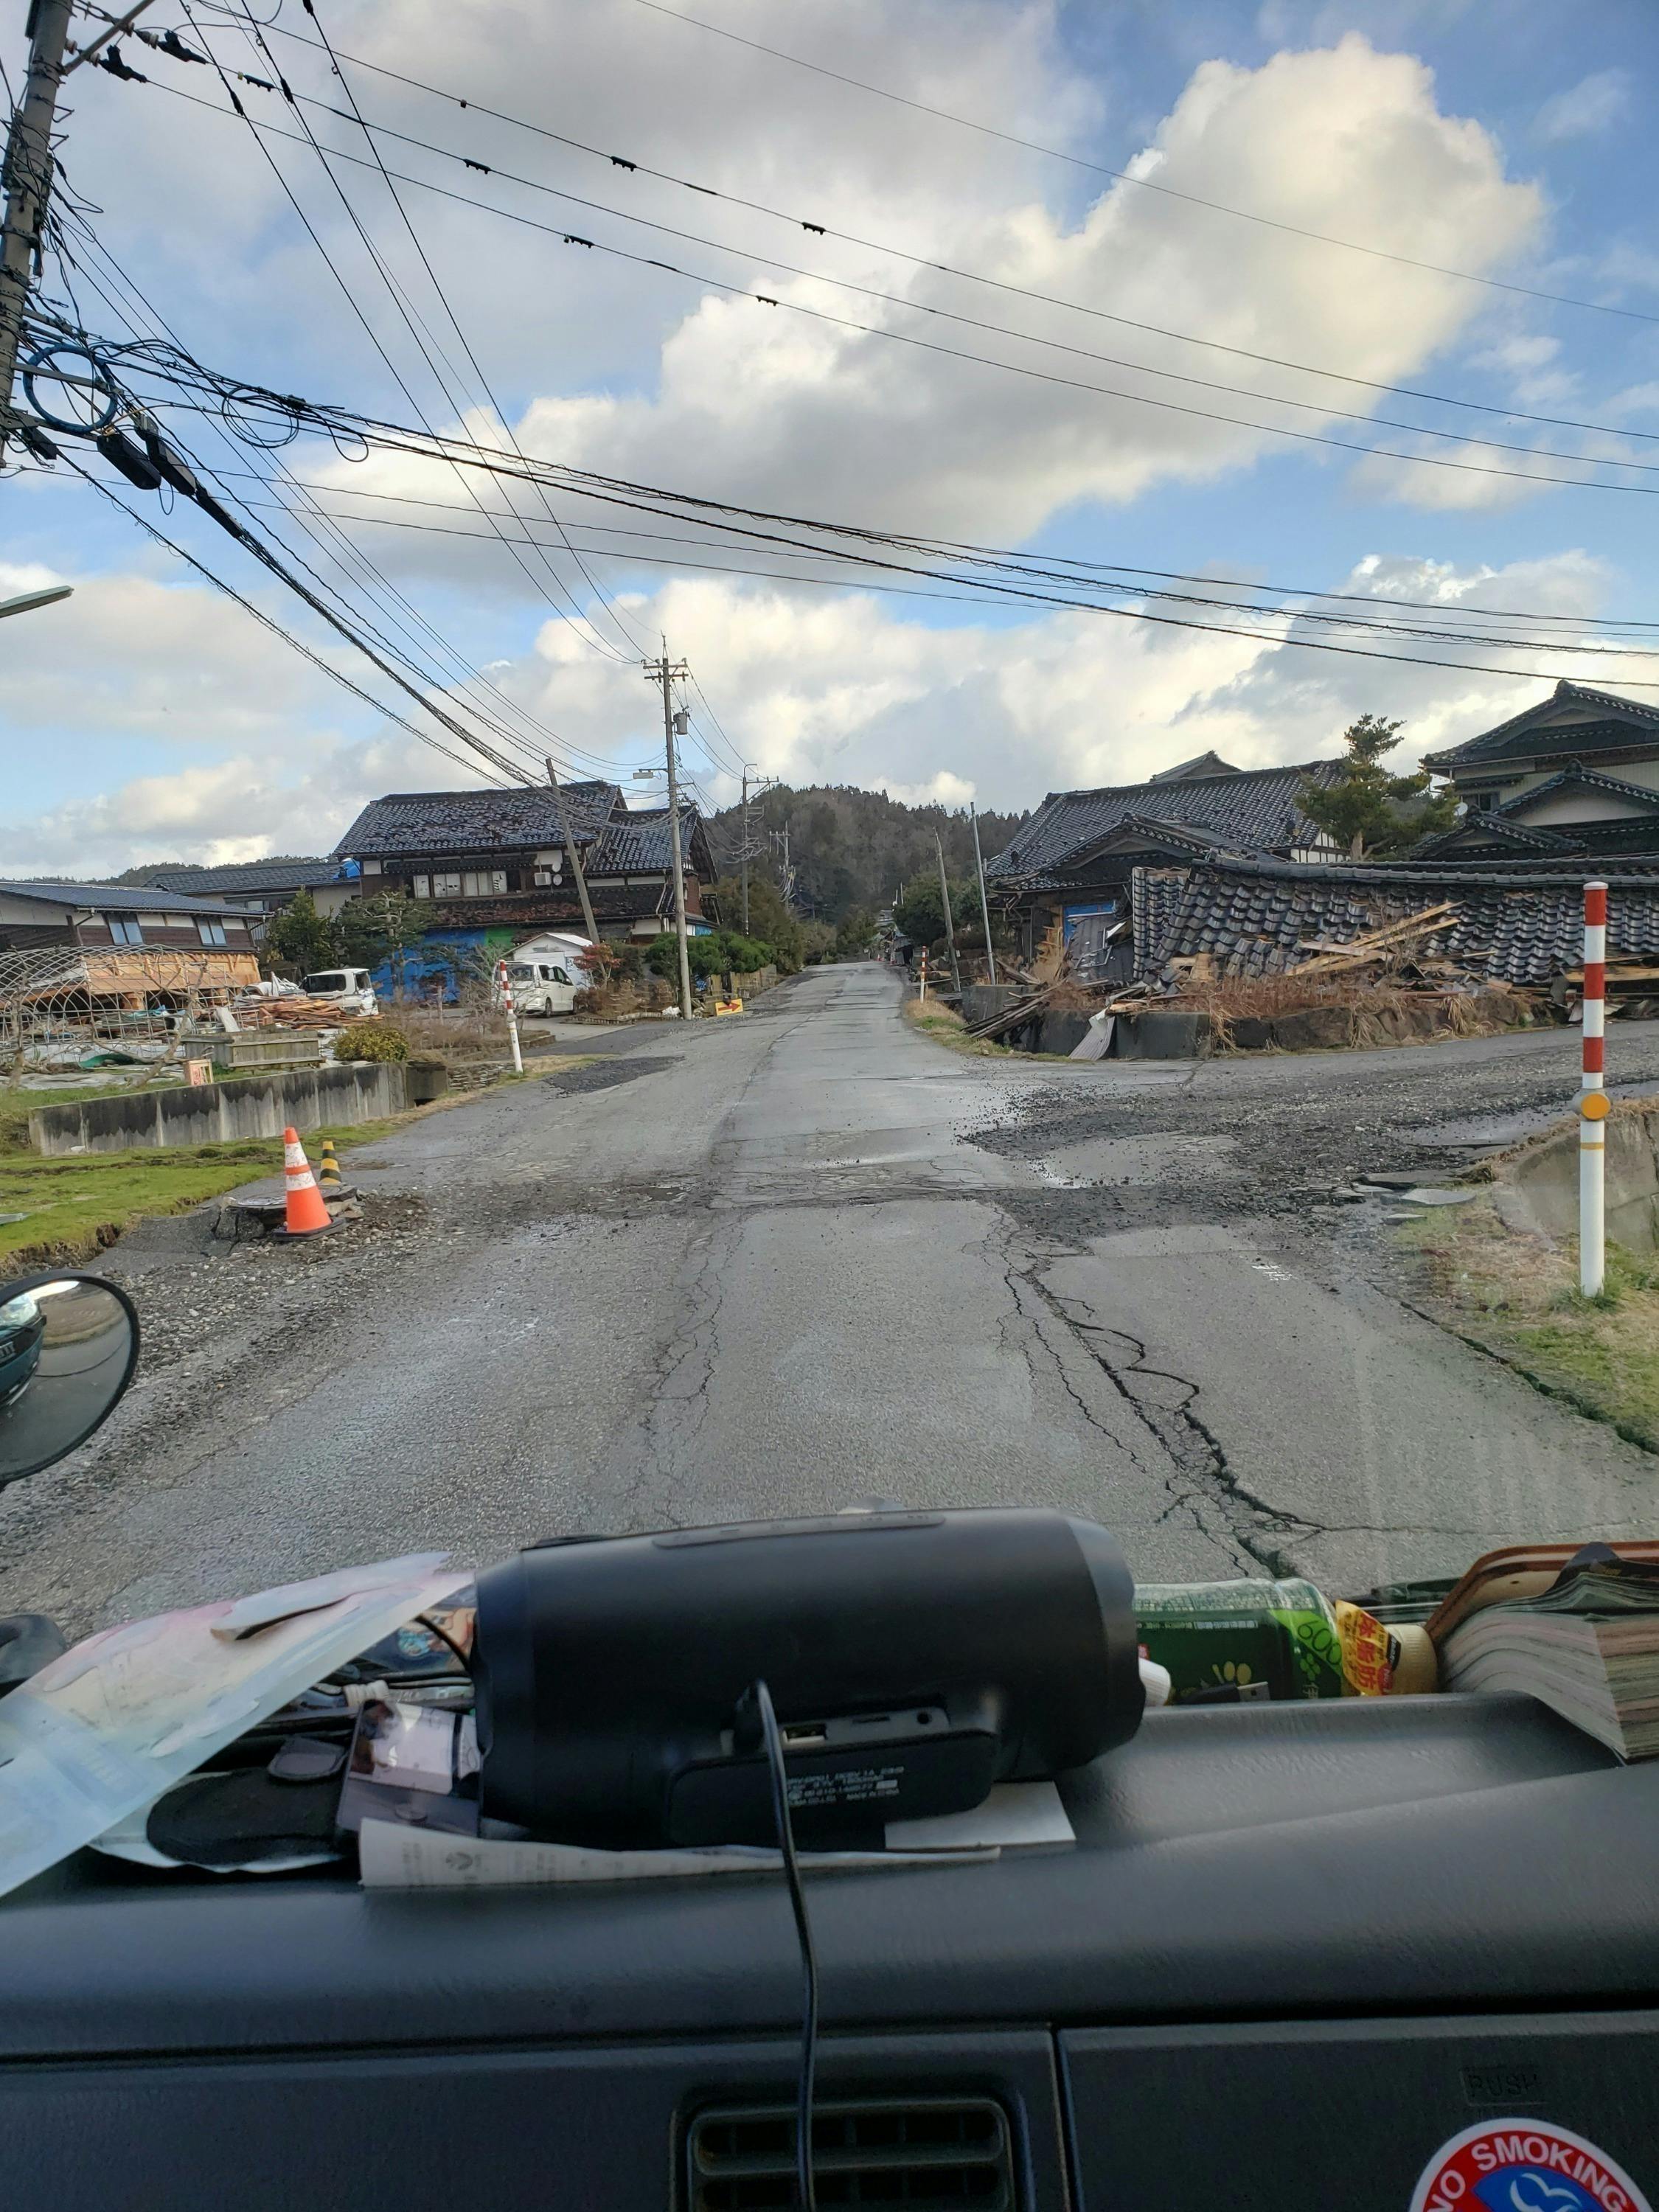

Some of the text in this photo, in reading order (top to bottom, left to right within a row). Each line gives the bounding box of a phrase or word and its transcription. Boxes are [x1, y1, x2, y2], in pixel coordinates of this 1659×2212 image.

[1298, 1621, 1342, 1665] 600
[1355, 1613, 1377, 1690] 体脂肪
[1470, 2135, 1627, 2212] SMOKING
